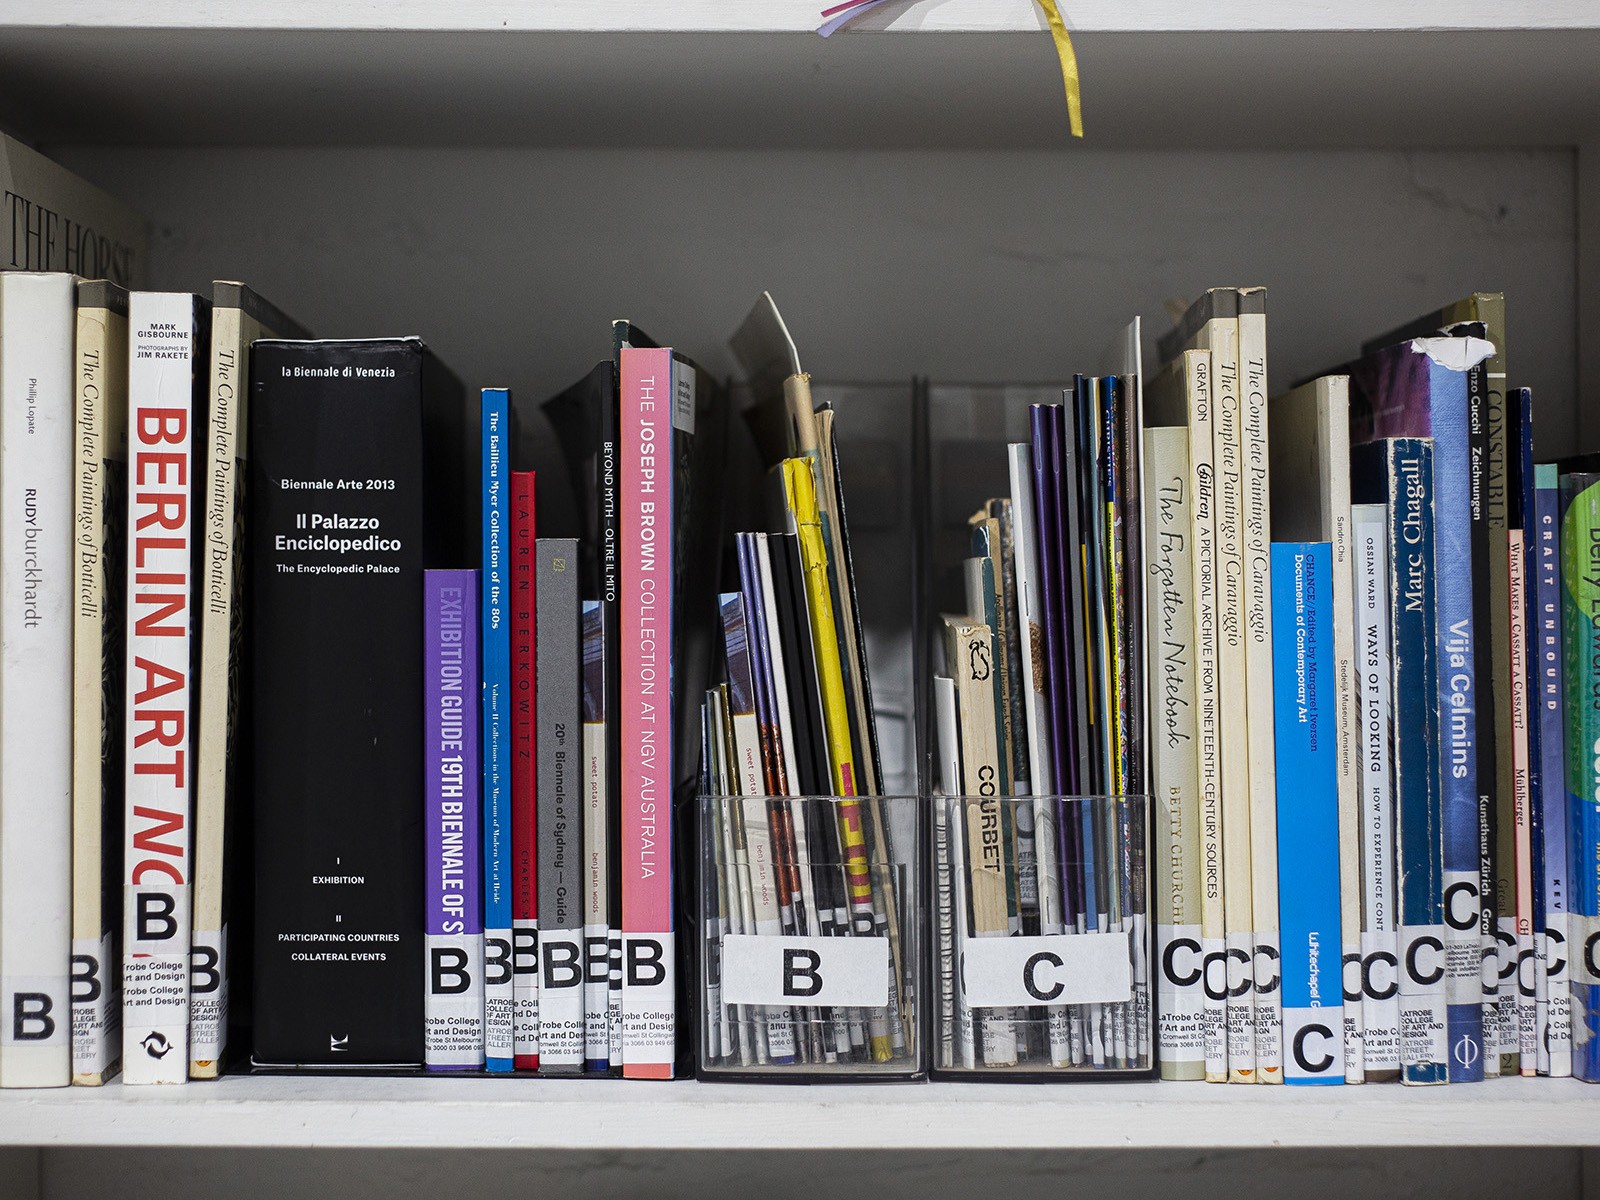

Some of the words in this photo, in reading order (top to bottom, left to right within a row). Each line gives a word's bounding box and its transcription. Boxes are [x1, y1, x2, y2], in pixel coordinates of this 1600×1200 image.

[138, 332, 189, 340] GISBOURNE
[84, 352, 100, 381] The
[219, 350, 235, 381] The
[282, 366, 291, 377] la
[294, 366, 339, 377] Biennale
[342, 366, 352, 377] di
[355, 367, 395, 378] Venezia
[1221, 362, 1236, 392] The
[1248, 357, 1264, 388] The
[1470, 363, 1481, 393] Enzo
[27, 379, 37, 404] Phillip
[640, 375, 655, 412] THE
[1196, 363, 1208, 422] GRAFTON
[26, 406, 37, 435] Lopate
[79, 386, 100, 457] Complete
[212, 384, 235, 455] Complete
[490, 411, 499, 432] The
[1218, 397, 1239, 467] Complete
[1245, 391, 1266, 464] Complete
[1470, 396, 1482, 436] Cucchi
[490, 435, 500, 478] Baillieu
[604, 441, 613, 486] BEYOND
[640, 419, 656, 493] JOSEPH
[1488, 389, 1505, 531] CONSTABLE
[79, 461, 99, 532] Paintings
[209, 459, 232, 529] Paintings
[281, 479, 334, 490] Biennale
[336, 479, 363, 490] Arte
[366, 479, 395, 490] 2013
[488, 480, 500, 507] Myer
[604, 487, 614, 518] MYTH
[1160, 476, 1183, 525] The
[1196, 463, 1214, 521] Children
[1220, 470, 1240, 540] Paintings
[1247, 466, 1267, 536] Paintings
[1401, 458, 1426, 545] Chagall
[1471, 447, 1482, 522] Zeichnungen
[77, 533, 98, 548] of
[135, 407, 188, 638] BERLIN
[208, 530, 230, 548] of
[275, 535, 402, 554] Enciclopedico
[296, 514, 306, 529] Il
[312, 514, 380, 530] Palazzo
[491, 510, 501, 569] Collection
[518, 494, 530, 591] LAUREN
[605, 528, 614, 561] OLTRE
[640, 502, 656, 571] BROWN
[1201, 527, 1211, 536] A
[1337, 516, 1345, 546] Sandro
[276, 564, 295, 573] The
[297, 564, 364, 574] Encyclopedic
[366, 564, 400, 574] Palace
[606, 563, 615, 572] IL
[1201, 540, 1212, 600] PICTORIAL
[1221, 542, 1241, 560] of
[1249, 538, 1269, 560] of
[1366, 537, 1374, 576] OSSIAN
[1543, 515, 1553, 586] CRAFT
[82, 548, 98, 619] Botticelli
[211, 548, 229, 616] Botticelli
[491, 571, 501, 583] of
[491, 584, 501, 605] the
[606, 574, 616, 602] MITO
[1150, 530, 1185, 638] Forgotten
[1250, 558, 1269, 644] Caravaggio
[1294, 554, 1305, 615] Documents
[1367, 578, 1375, 611] WARD
[1405, 554, 1424, 613] Marc
[491, 607, 501, 630] 80s
[1223, 560, 1243, 647] Caravaggio
[1297, 616, 1306, 627] of
[440, 587, 462, 692] EXHIBITION
[640, 578, 657, 696] COLLECTION
[1201, 604, 1213, 656] ARCHIVE
[1309, 644, 1318, 660] by
[1367, 624, 1378, 667] WAYS
[1444, 619, 1470, 668] Vija
[1203, 660, 1214, 695] FROM
[1296, 629, 1308, 707] Contemporary
[1341, 659, 1349, 694] Stedelijk
[1544, 603, 1557, 710] UNBOUND
[519, 611, 530, 760] BERKOWITZ
[1161, 641, 1191, 750] Notebook
[1308, 662, 1319, 712] Margaret
[1368, 673, 1379, 695] OF
[134, 655, 186, 789] ART
[440, 695, 463, 752] GUIDE
[641, 702, 656, 724] AT
[1299, 709, 1309, 724] Art
[1311, 715, 1320, 754] Iversen
[1368, 700, 1381, 773] LOOKING
[1449, 674, 1472, 779] Celmins
[641, 731, 656, 771] NGV
[746, 748, 755, 771] sweet
[1203, 700, 1218, 839] NINETEENTH-CENTURY
[441, 755, 464, 799] 19TH
[555, 752, 567, 807] Biennale
[1373, 787, 1381, 812] HOW
[1514, 768, 1523, 827] Mühlberger
[556, 808, 565, 821] of
[640, 775, 656, 880] AUSTRALIA
[978, 765, 1001, 872] COURBET
[1168, 786, 1182, 841] BETTY
[1373, 815, 1381, 830] TO
[1479, 794, 1489, 856] Kunsthaus
[441, 802, 464, 890] BIENNALE
[554, 822, 566, 868] Sydney
[1374, 833, 1383, 900] EXPERIENCE
[313, 876, 365, 884] EXHIBITION
[760, 881, 768, 906] woods
[1205, 841, 1218, 899] SOURCES
[1480, 858, 1491, 896] Zürich
[137, 893, 178, 941] B
[442, 894, 464, 918] OF
[556, 887, 567, 925] Guide
[1444, 881, 1480, 931] C
[278, 934, 346, 942] PARTICIPATING
[348, 934, 400, 942] COUNTRIES
[291, 953, 349, 961] COLLATERAL
[351, 953, 387, 961] EVENTS
[485, 938, 513, 985] B
[513, 928, 539, 974] B
[1162, 937, 1203, 987] C
[1405, 935, 1445, 986] C
[70, 954, 102, 1004] B
[135, 973, 152, 982] and
[154, 972, 186, 982] Design
[148, 962, 183, 971] College
[191, 946, 221, 994] B
[431, 947, 471, 995] B
[542, 941, 582, 989] B
[626, 939, 666, 987] B
[782, 948, 823, 997] B
[1023, 951, 1066, 1001] C
[1227, 948, 1253, 998] C
[1253, 944, 1281, 995] C
[1307, 932, 1320, 999] Whitechapel
[1361, 951, 1399, 1001] C
[13, 992, 56, 1041] B
[1292, 1023, 1335, 1074] C
[1501, 1052, 1513, 1069] 2
